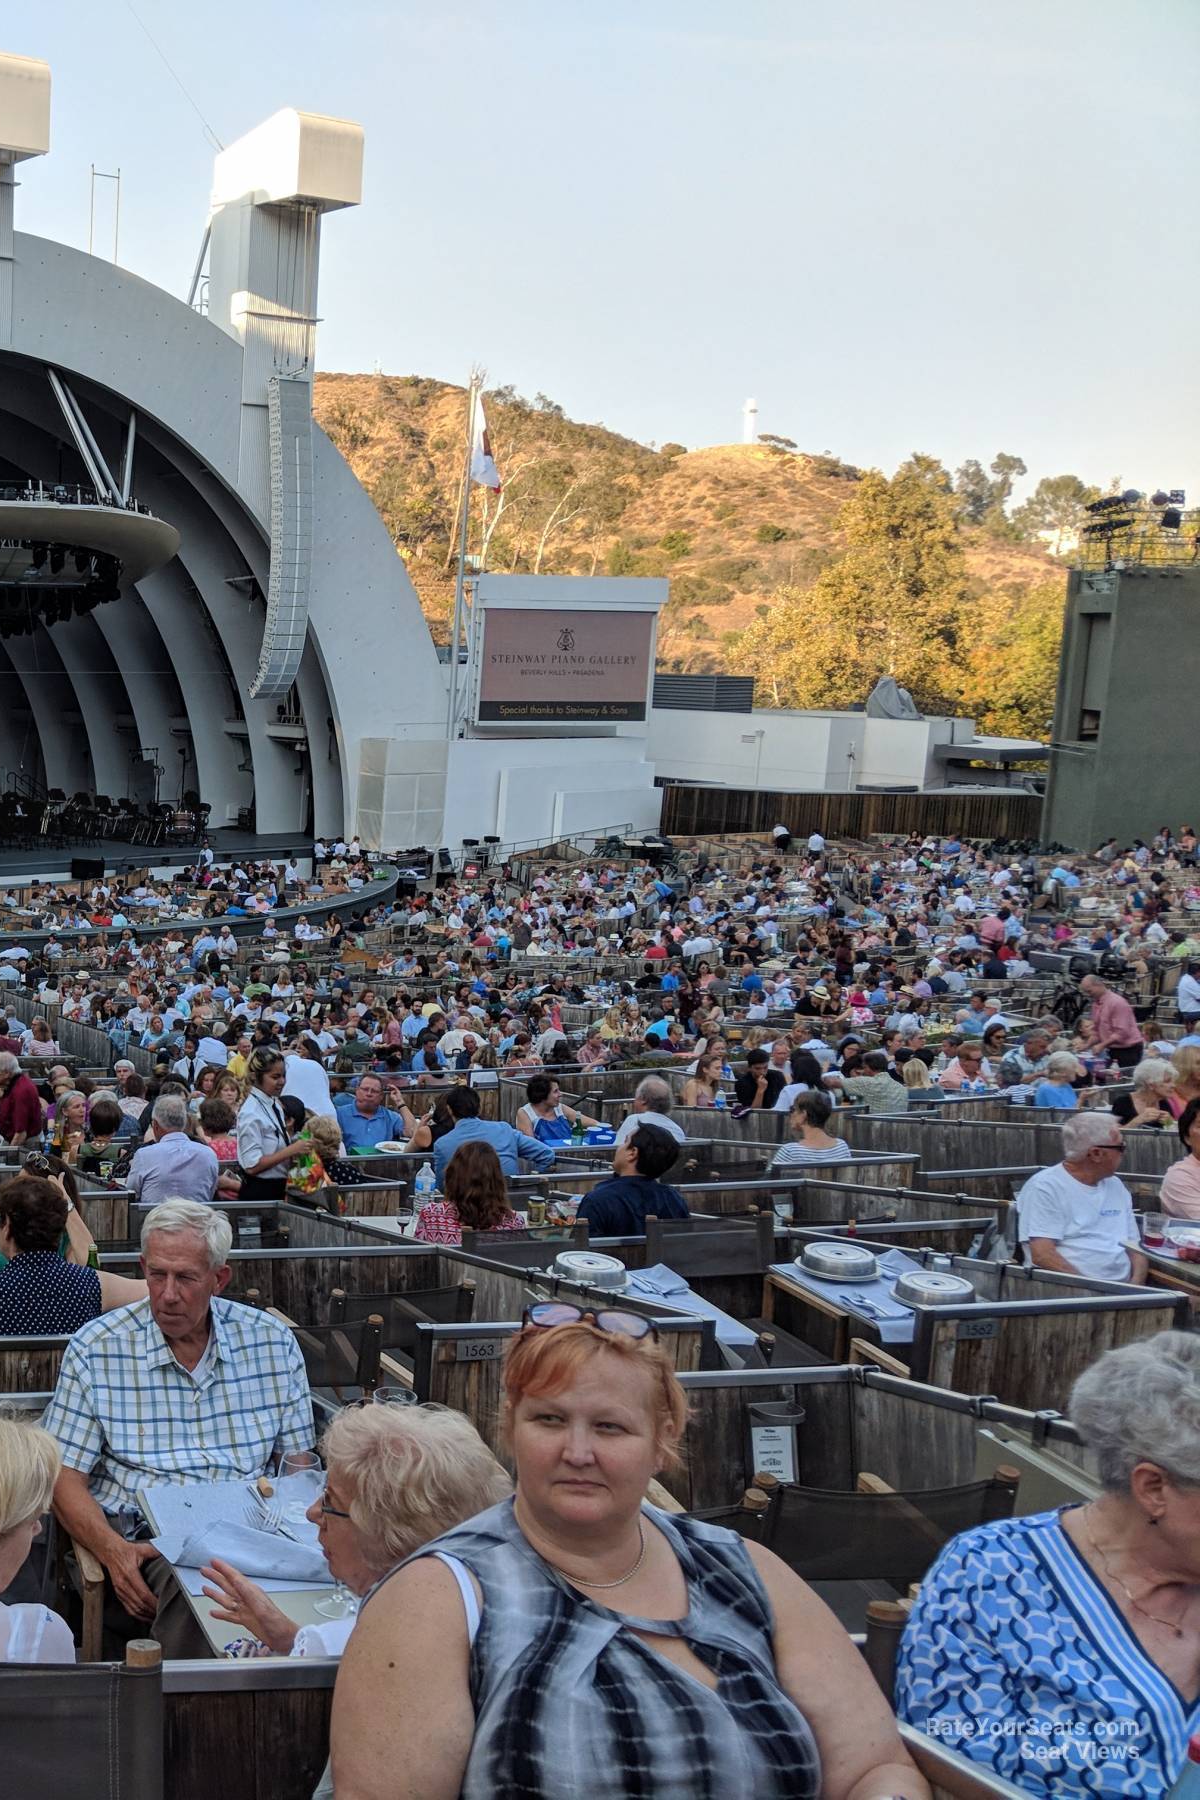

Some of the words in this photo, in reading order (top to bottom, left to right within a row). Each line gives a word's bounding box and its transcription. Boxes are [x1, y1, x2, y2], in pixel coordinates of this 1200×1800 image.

[491, 654, 547, 664] STEINWAY
[551, 655, 585, 664] PIANO
[589, 655, 637, 665] GALLERY
[499, 704, 528, 716] Special
[530, 705, 554, 714] thanks
[556, 705, 564, 714] to
[565, 704, 600, 716] Steinway
[601, 705, 608, 714] &
[610, 705, 628, 714] Sons
[465, 1344, 495, 1357] 1563
